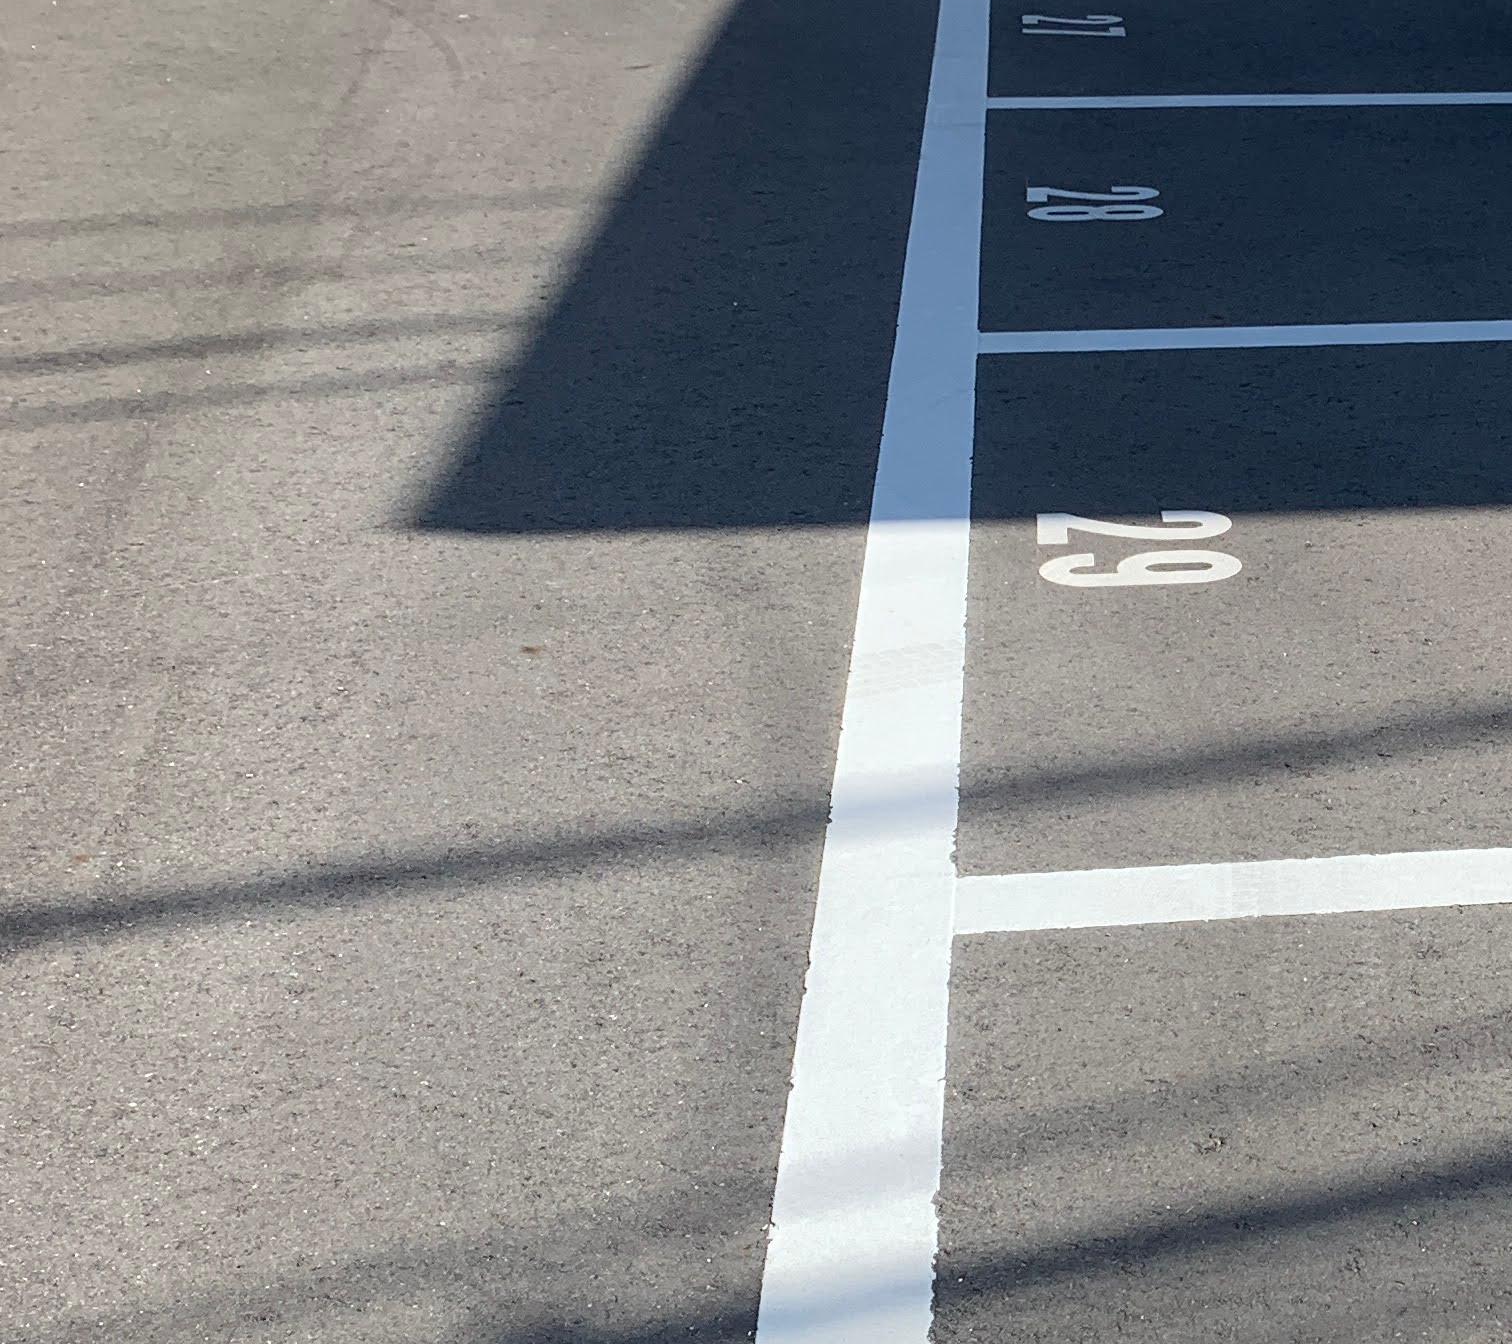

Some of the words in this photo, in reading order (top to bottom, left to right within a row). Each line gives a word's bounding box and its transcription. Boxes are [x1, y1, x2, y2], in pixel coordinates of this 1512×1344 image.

[1021, 14, 1126, 37] 27
[1026, 186, 1164, 222] 28
[1037, 510, 1243, 587] 29
